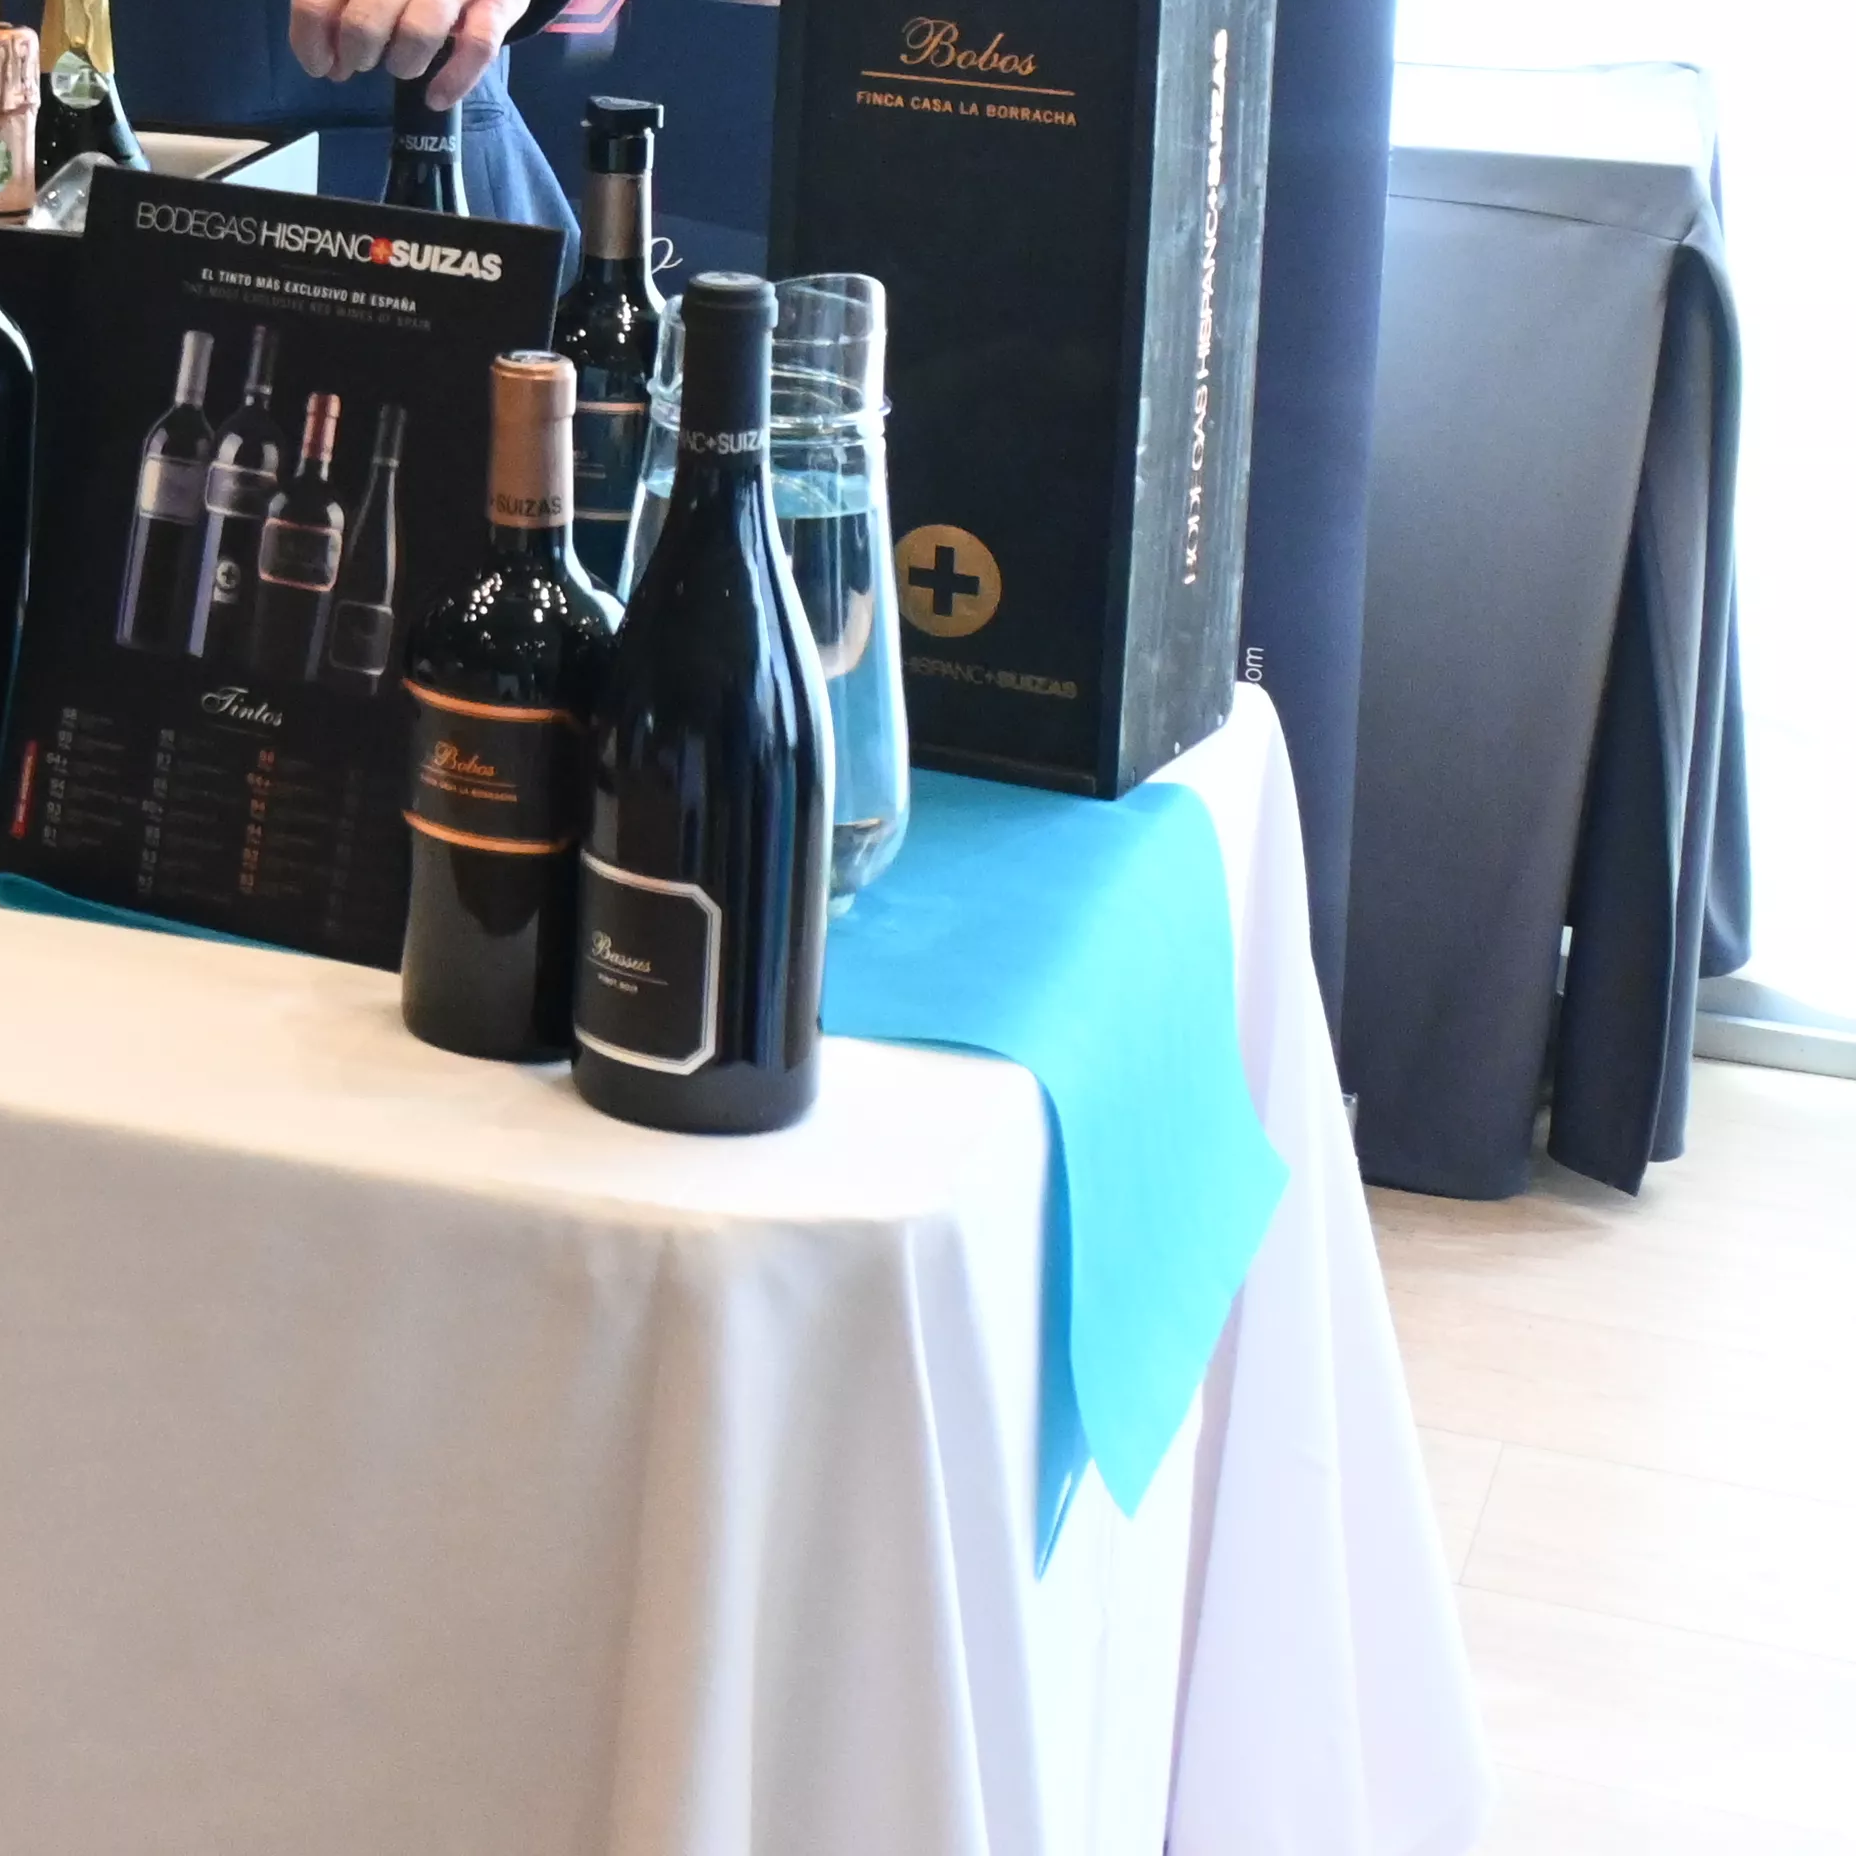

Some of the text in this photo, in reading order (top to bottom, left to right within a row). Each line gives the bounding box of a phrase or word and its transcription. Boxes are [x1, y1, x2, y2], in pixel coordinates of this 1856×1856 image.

[899, 16, 1037, 76] Bobos
[856, 91, 1077, 126] FINCA CASA LA BORRACHA
[135, 201, 257, 244] BODEGAS
[201, 268, 417, 313] EL TINTO MÁS EXCLUSIVO DE ESPAÑA
[201, 686, 284, 727] Tintos
[432, 739, 497, 778] Bobos
[592, 929, 652, 974] Bassus
